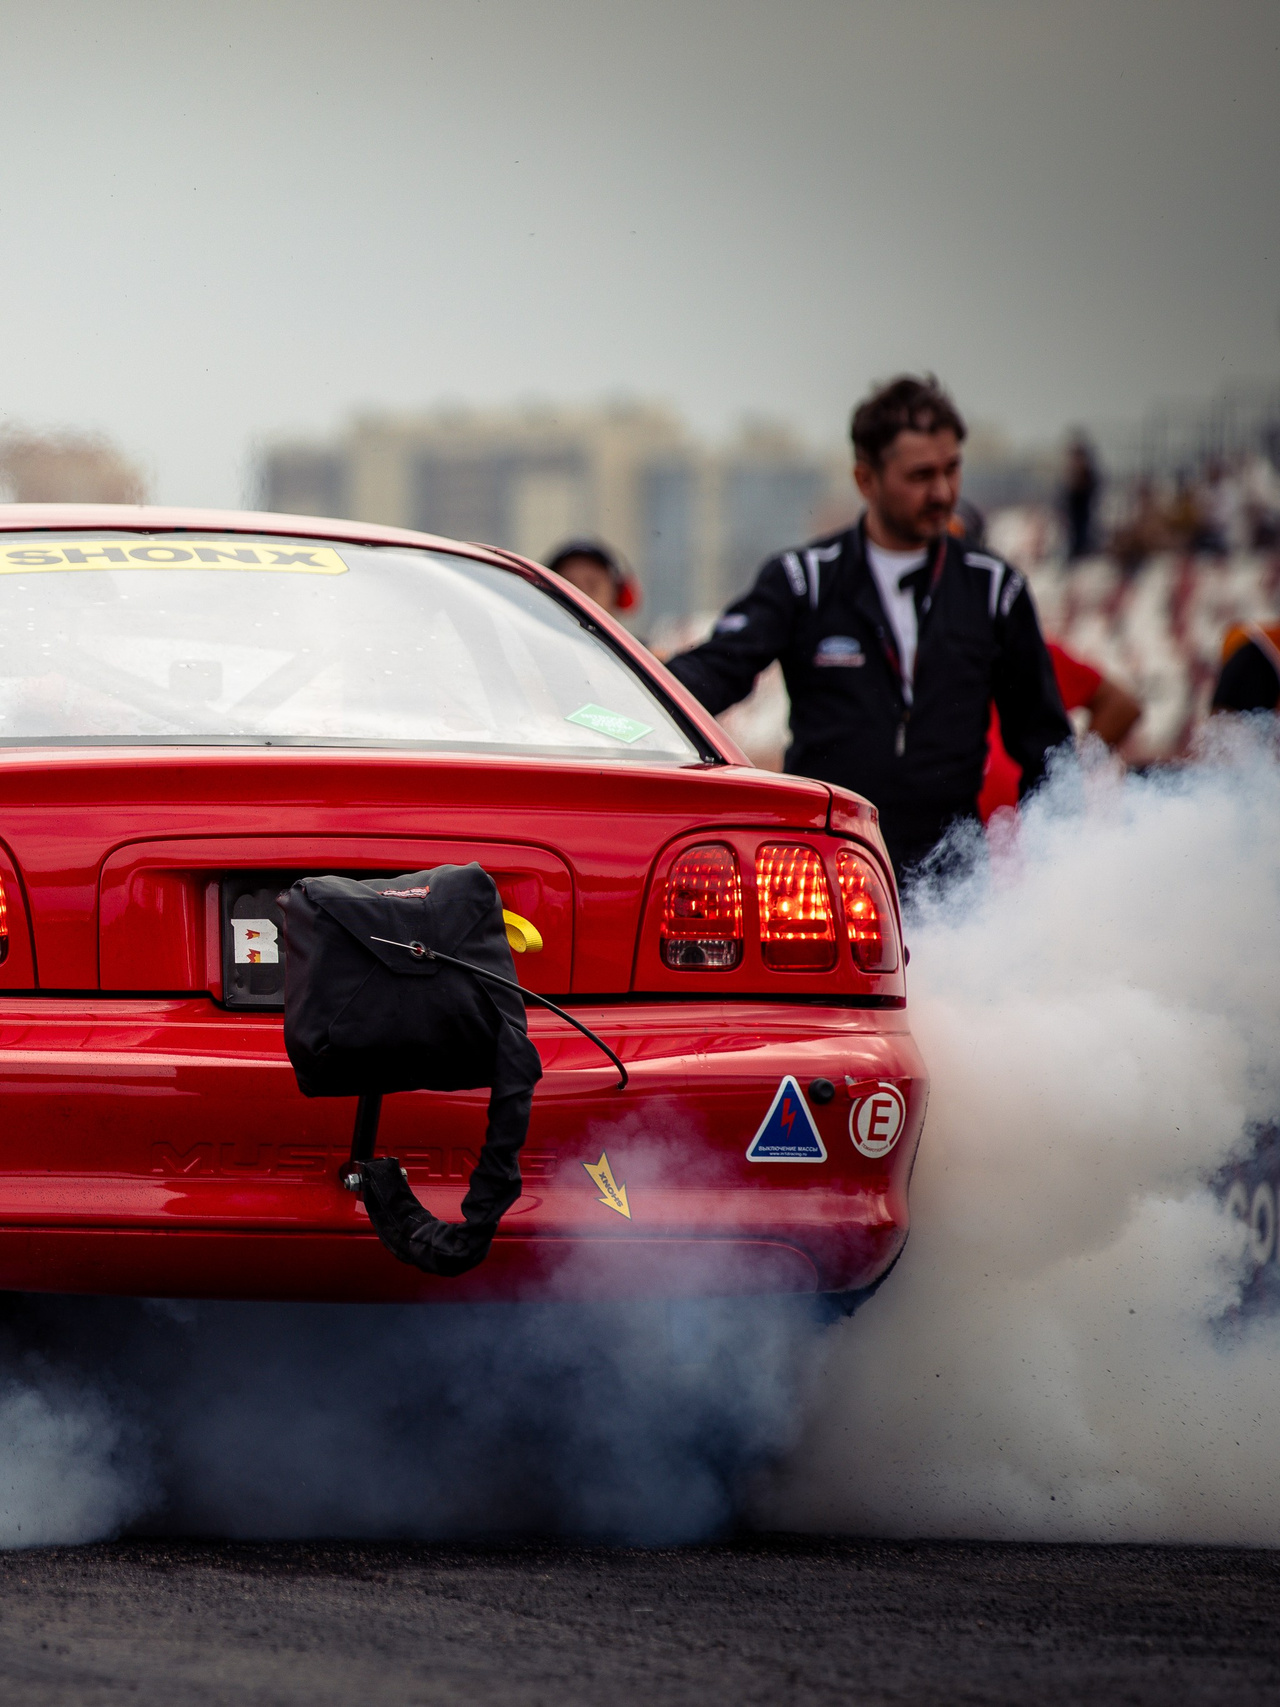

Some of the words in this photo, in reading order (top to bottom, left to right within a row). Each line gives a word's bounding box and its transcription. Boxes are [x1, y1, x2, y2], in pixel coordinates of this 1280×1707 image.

[5, 546, 328, 568] SHONX
[867, 1099, 892, 1141] E
[598, 1171, 624, 1208] SHONX
